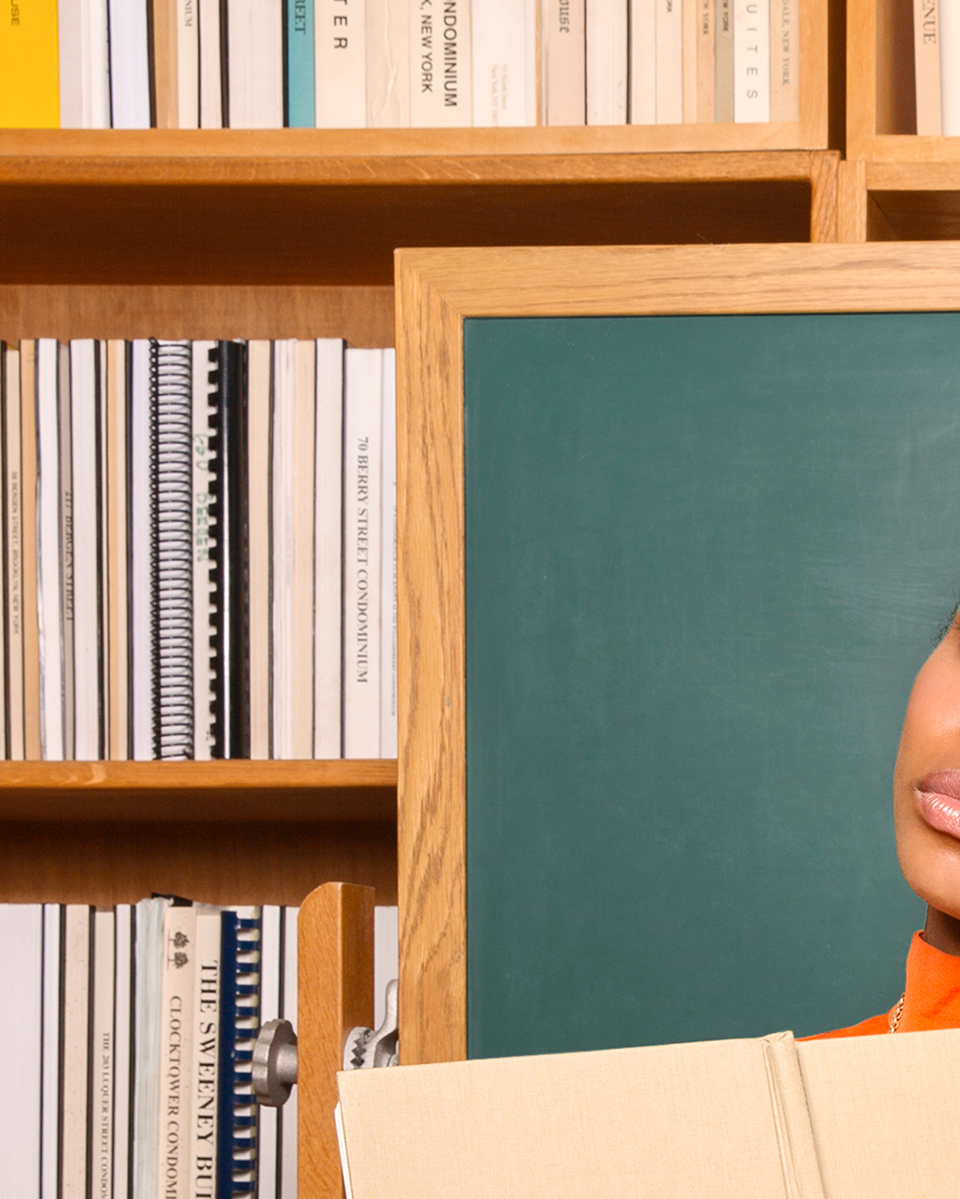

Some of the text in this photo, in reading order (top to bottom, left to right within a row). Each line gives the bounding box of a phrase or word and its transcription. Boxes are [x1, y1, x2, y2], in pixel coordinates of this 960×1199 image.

[421, 15, 433, 49] NEW
[722, 11, 730, 33] YORK
[782, 30, 790, 54] NEW
[421, 52, 433, 94] YORK
[443, 0, 457, 107] NDOMINIUM
[782, 56, 790, 86] YORK
[357, 436, 369, 683] 70 BERRY STREET CONDOMINIUM
[200, 960, 218, 1014] THE
[196, 1021, 217, 1145] SWEENEY
[101, 1116, 109, 1154] STREET
